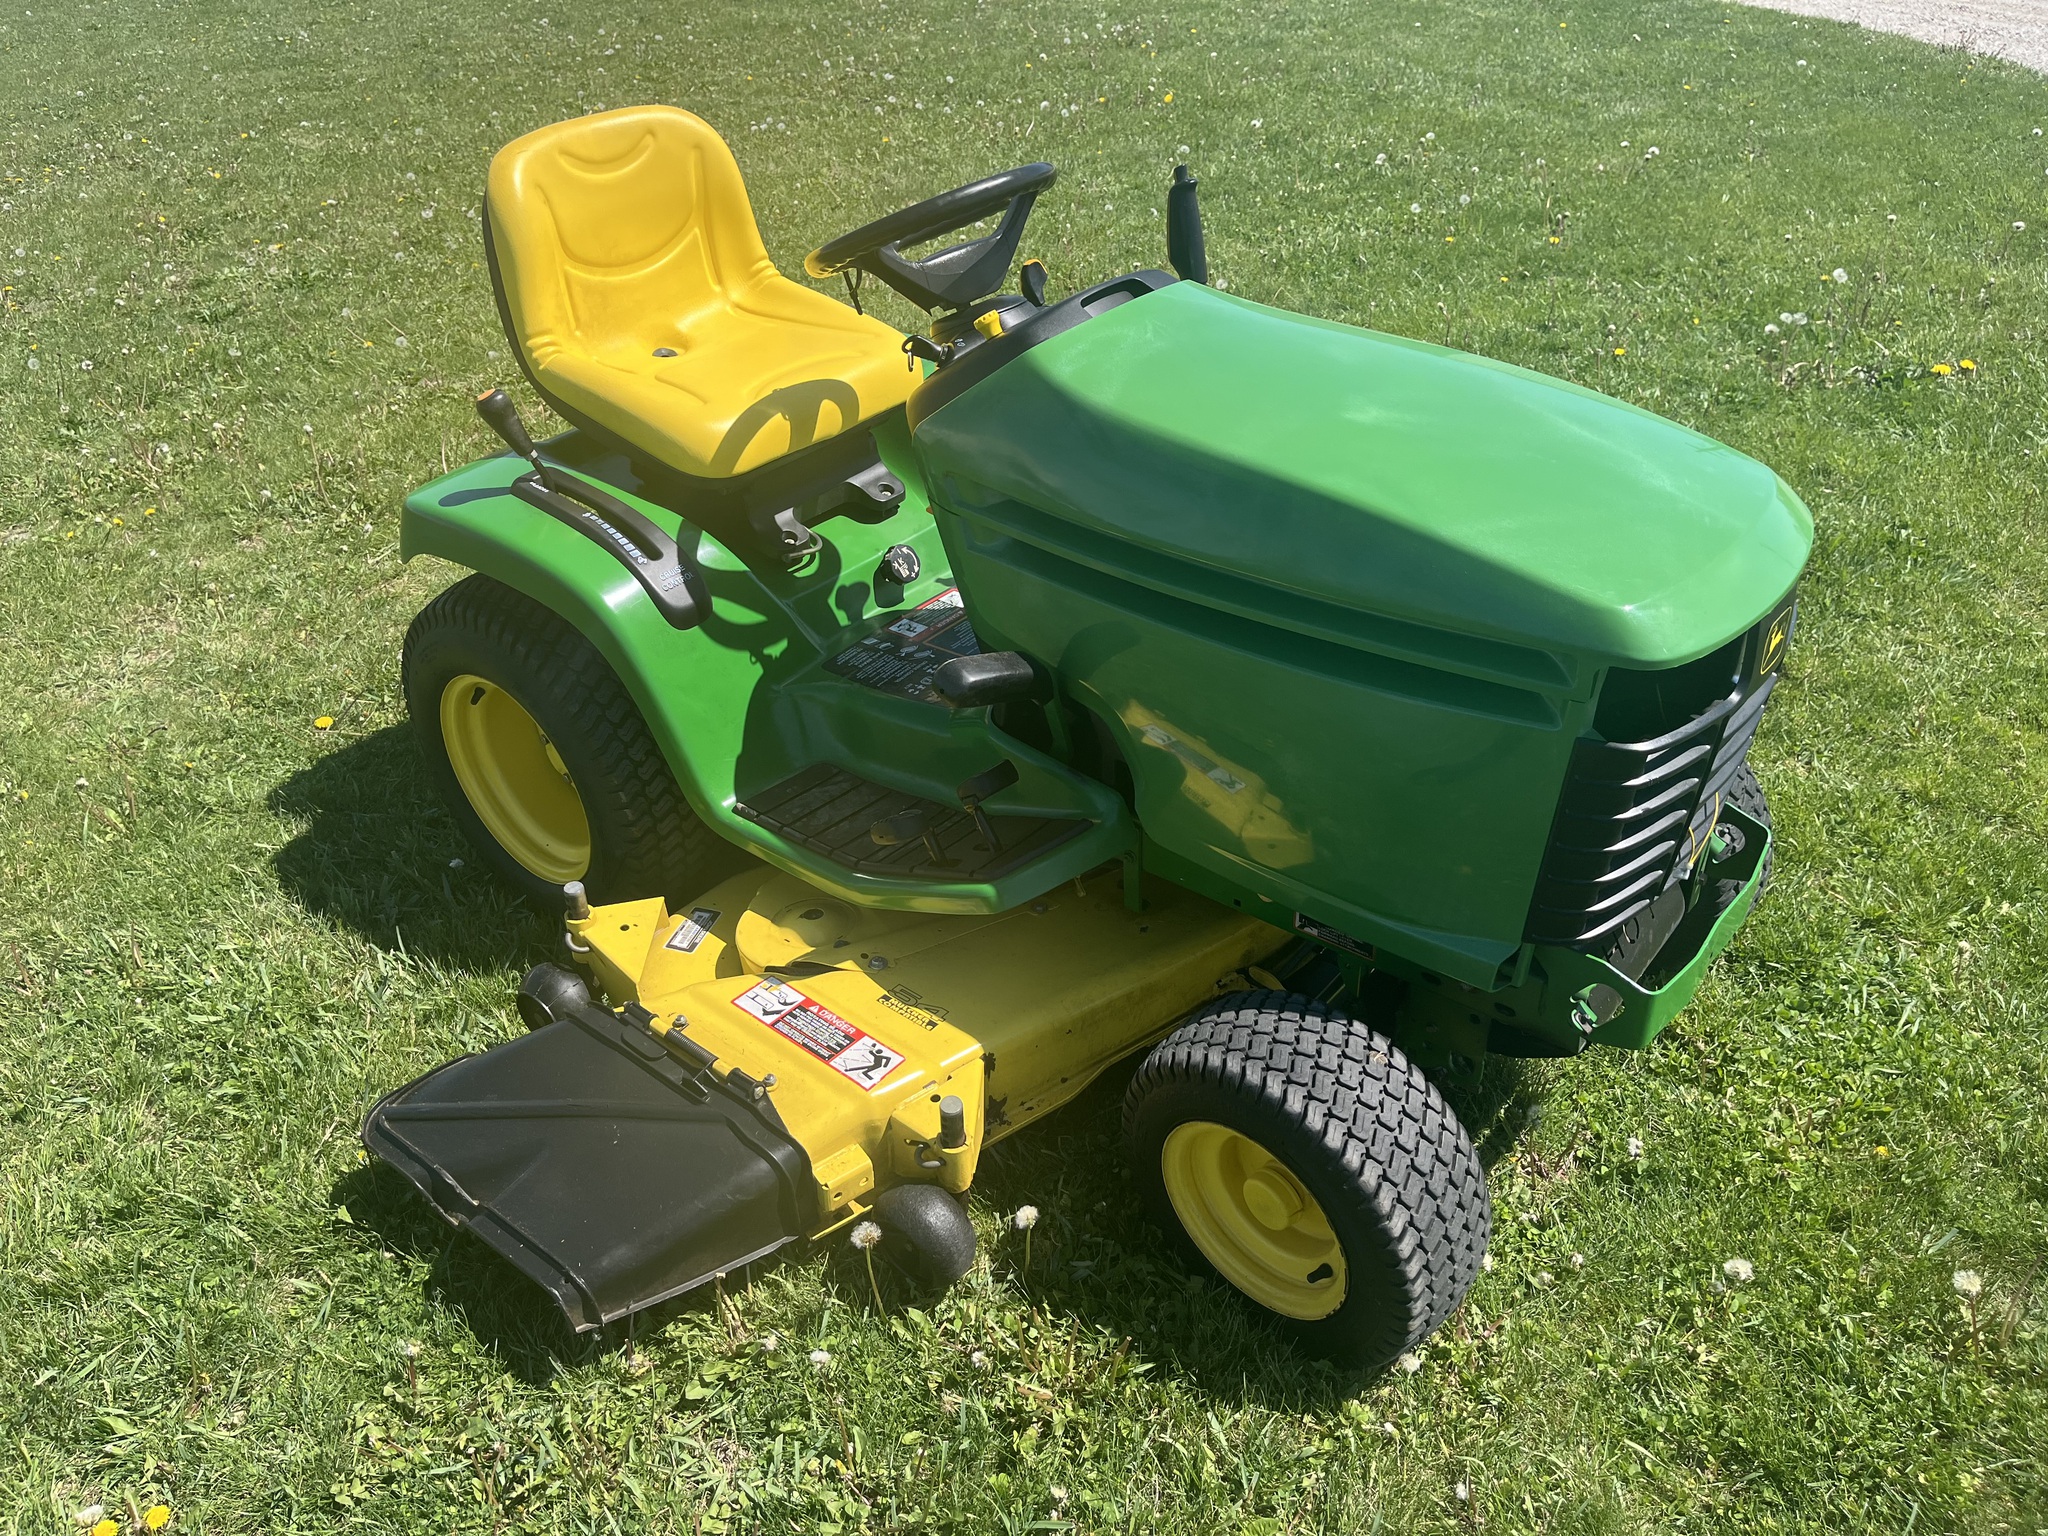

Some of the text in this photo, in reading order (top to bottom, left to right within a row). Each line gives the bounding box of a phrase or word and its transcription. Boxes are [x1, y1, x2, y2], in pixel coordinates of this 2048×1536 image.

[659, 564, 686, 581] CRUISE
[662, 572, 694, 591] CONTROL
[877, 998, 934, 1031] COMPATIBLE
[887, 984, 950, 1023] 54
[888, 998, 930, 1024] MULCHER
[818, 1009, 856, 1034] DANGER
